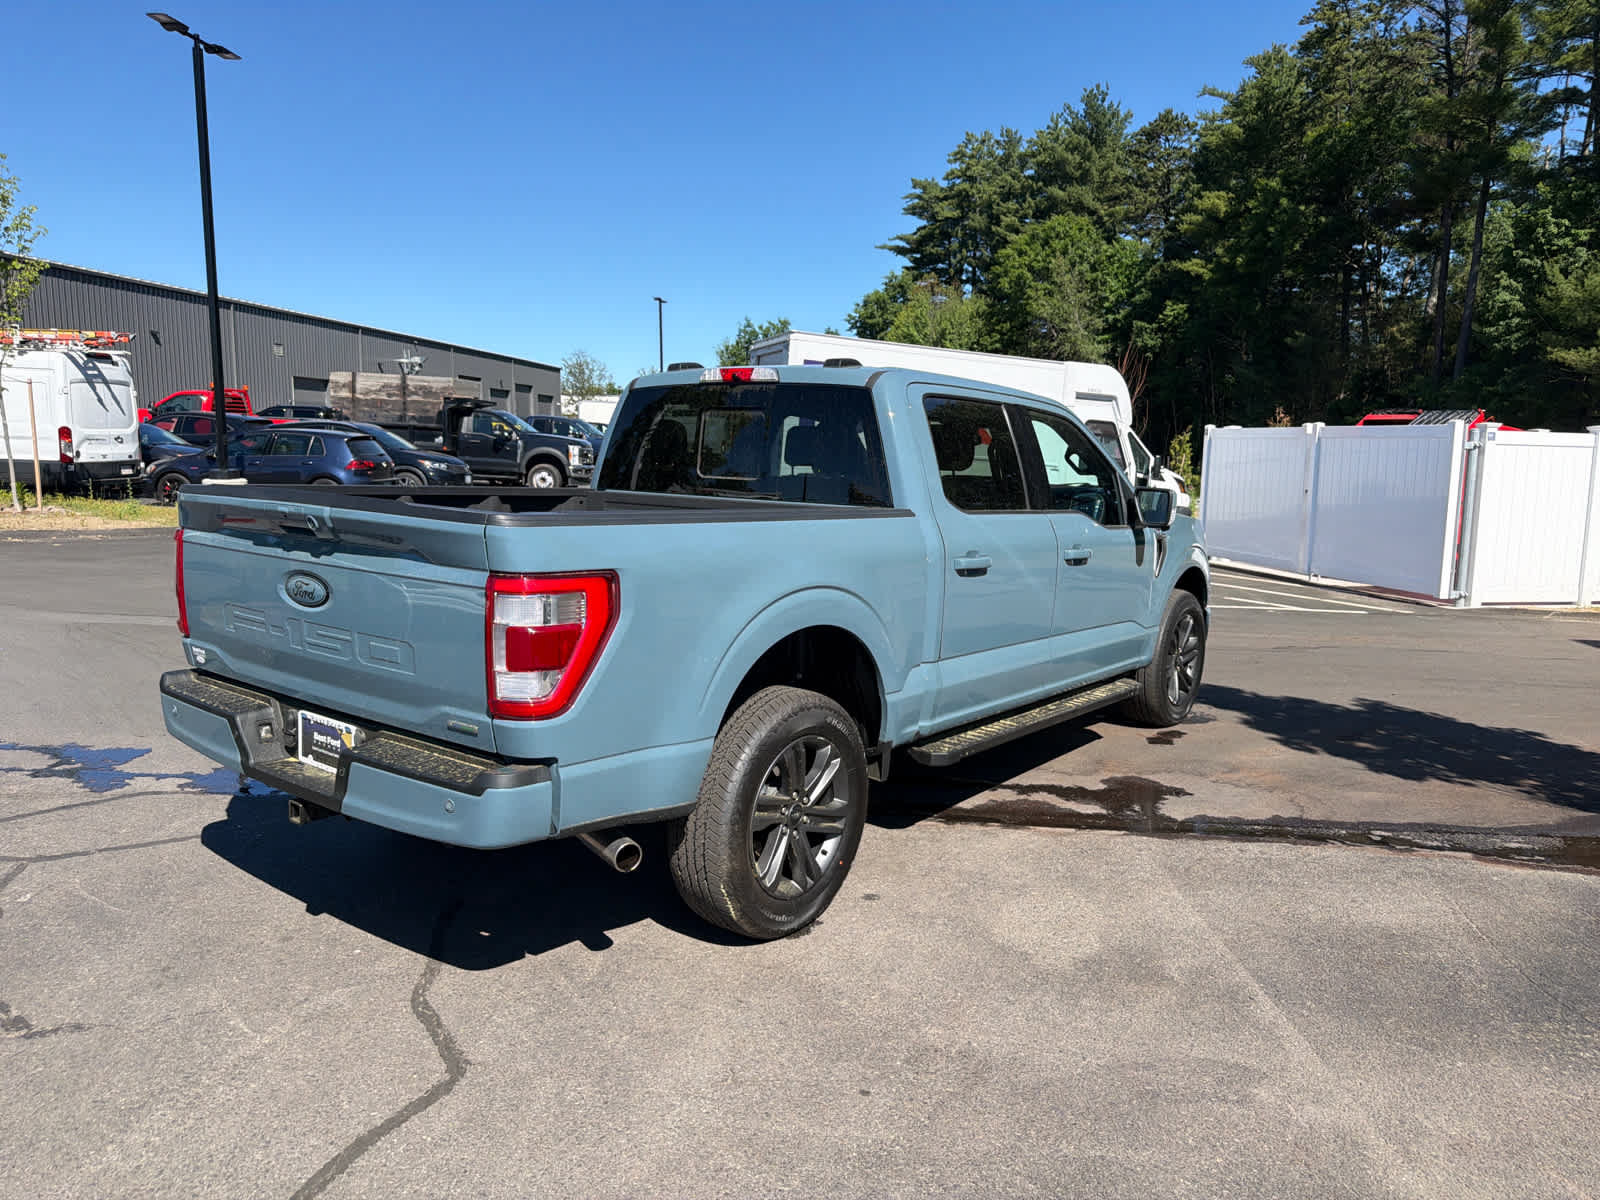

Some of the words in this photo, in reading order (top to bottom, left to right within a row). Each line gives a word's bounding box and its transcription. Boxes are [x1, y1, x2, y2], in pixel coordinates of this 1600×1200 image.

[292, 579, 316, 601] Ford
[223, 603, 416, 676] F-150
[327, 735, 341, 748] Ford
